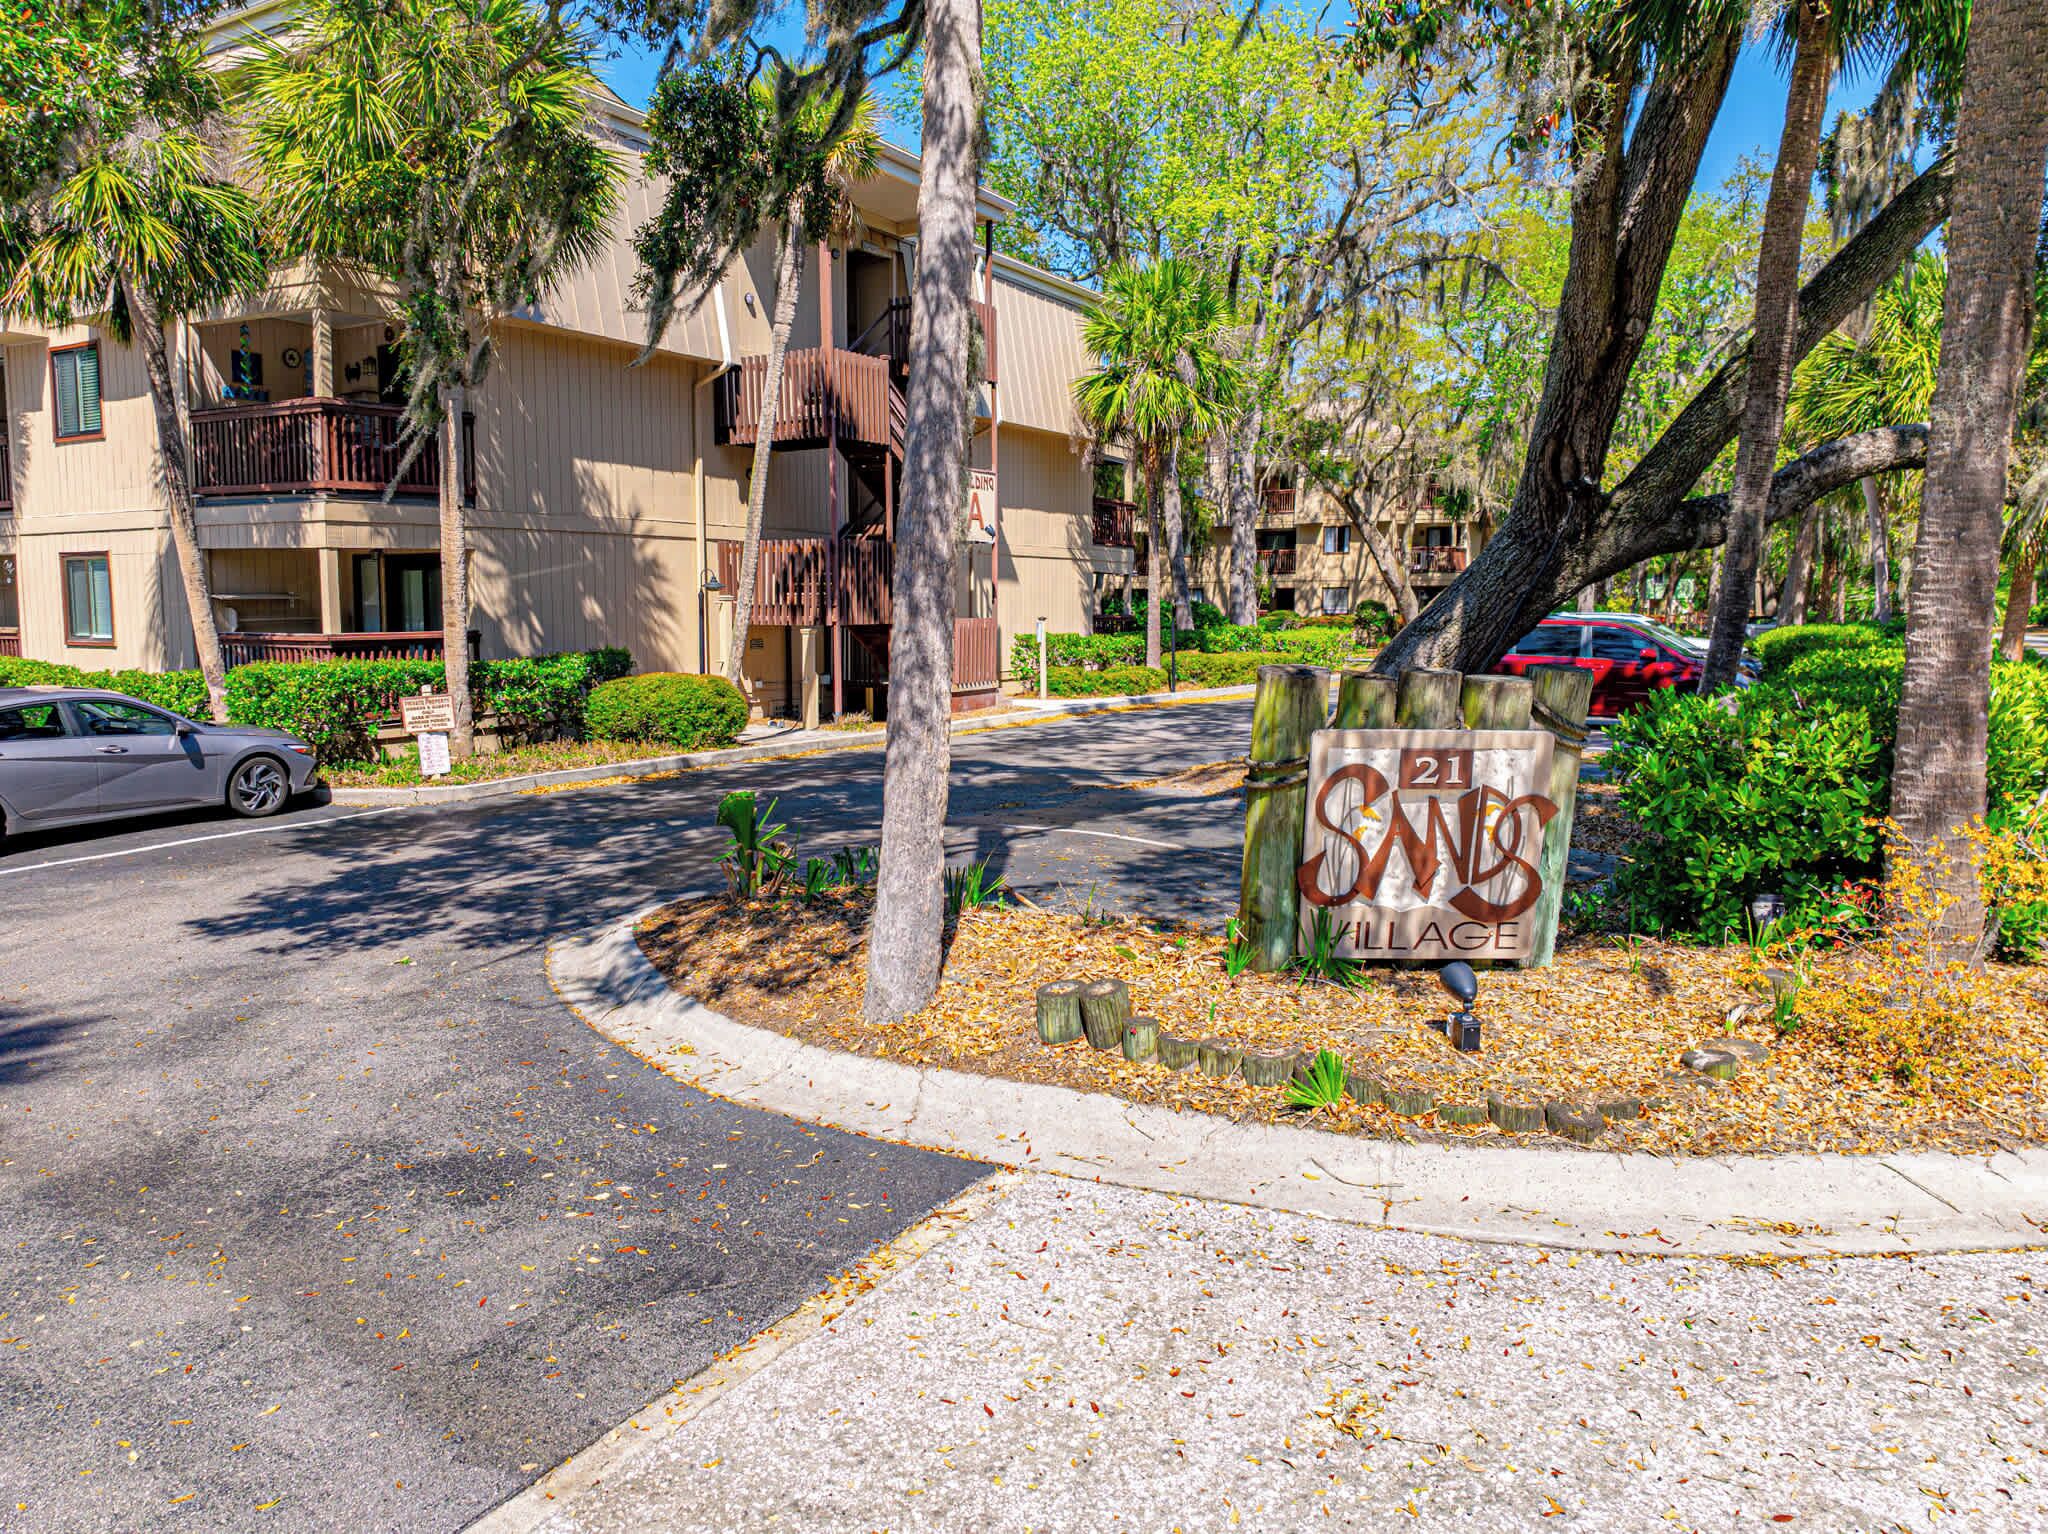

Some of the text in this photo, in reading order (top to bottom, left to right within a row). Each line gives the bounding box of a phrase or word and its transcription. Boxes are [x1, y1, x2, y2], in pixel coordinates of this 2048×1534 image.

[967, 492, 985, 529] A
[1410, 756, 1464, 784] 21
[1297, 763, 1559, 922] SANDS
